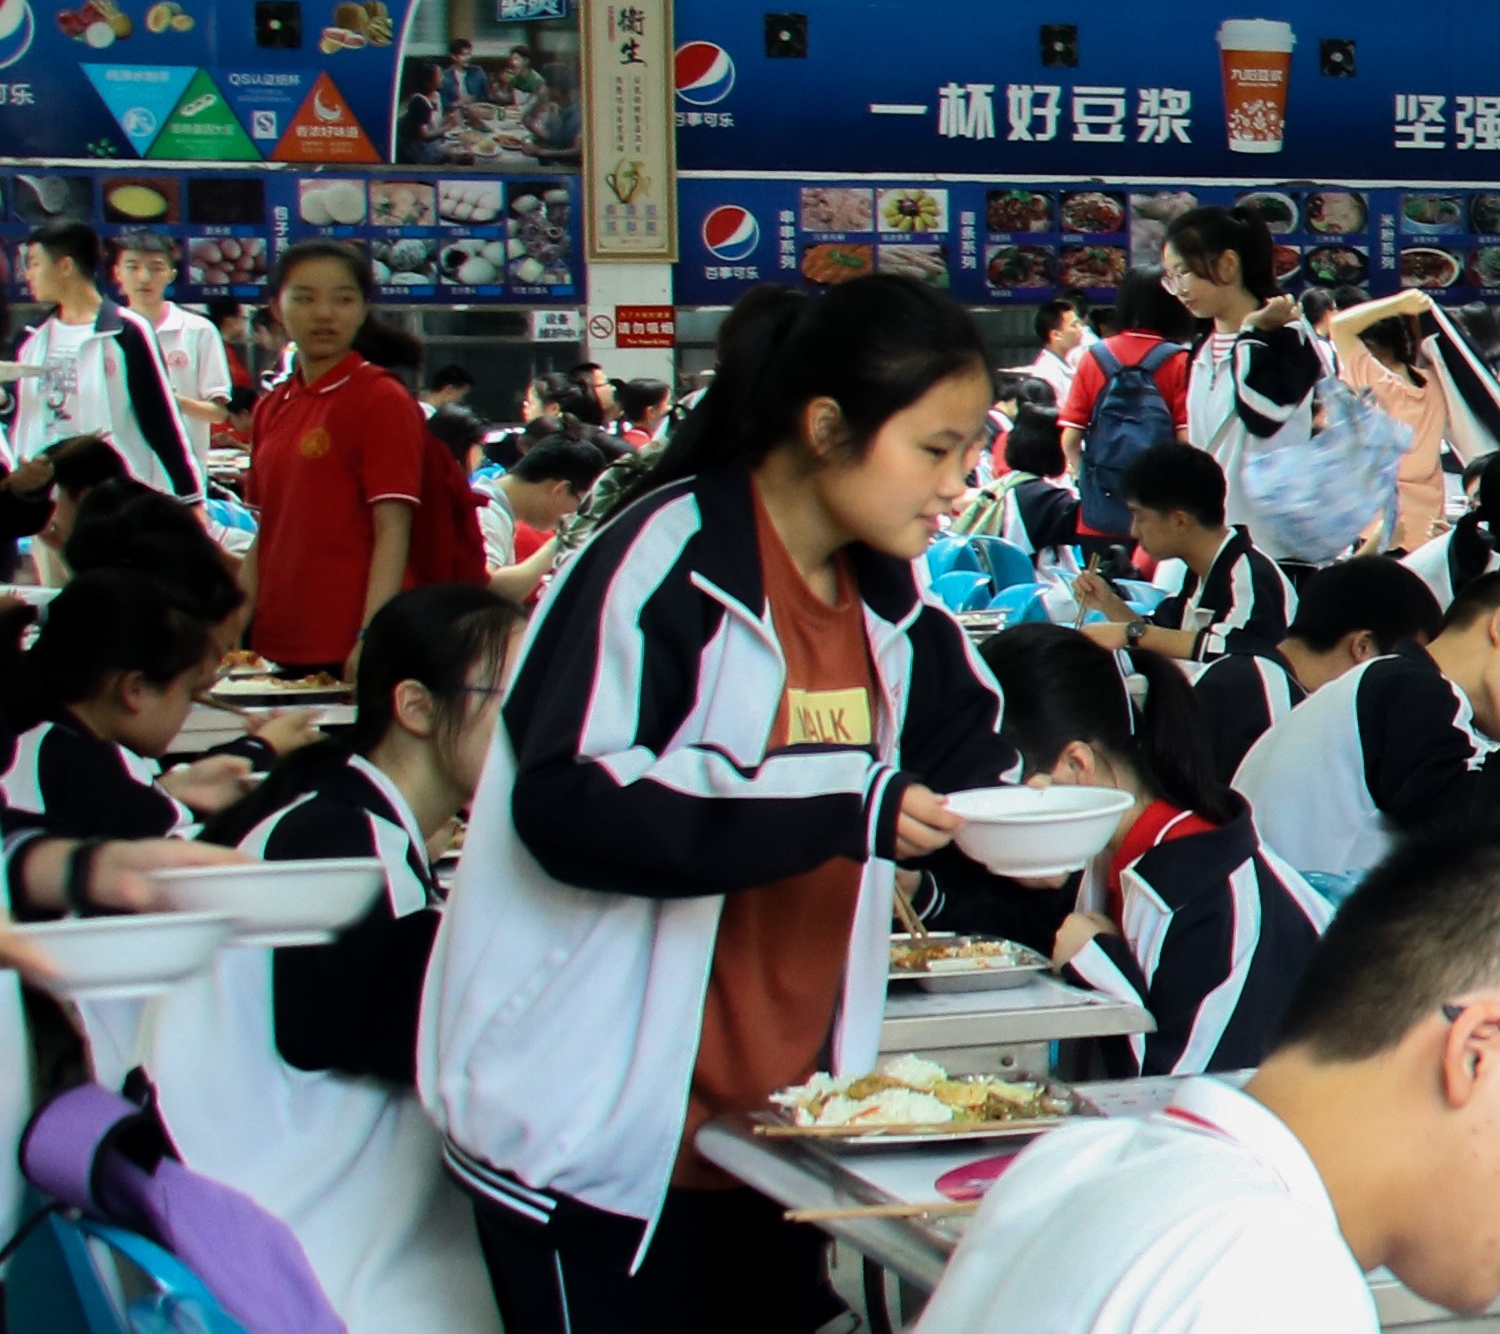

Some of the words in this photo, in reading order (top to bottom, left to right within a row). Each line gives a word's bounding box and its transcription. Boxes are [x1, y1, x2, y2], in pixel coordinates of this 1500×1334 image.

[870, 82, 1192, 144] 一杯好豆浆
[705, 266, 760, 281] 百事可乐
[618, 322, 674, 335] 请勿吸烟
